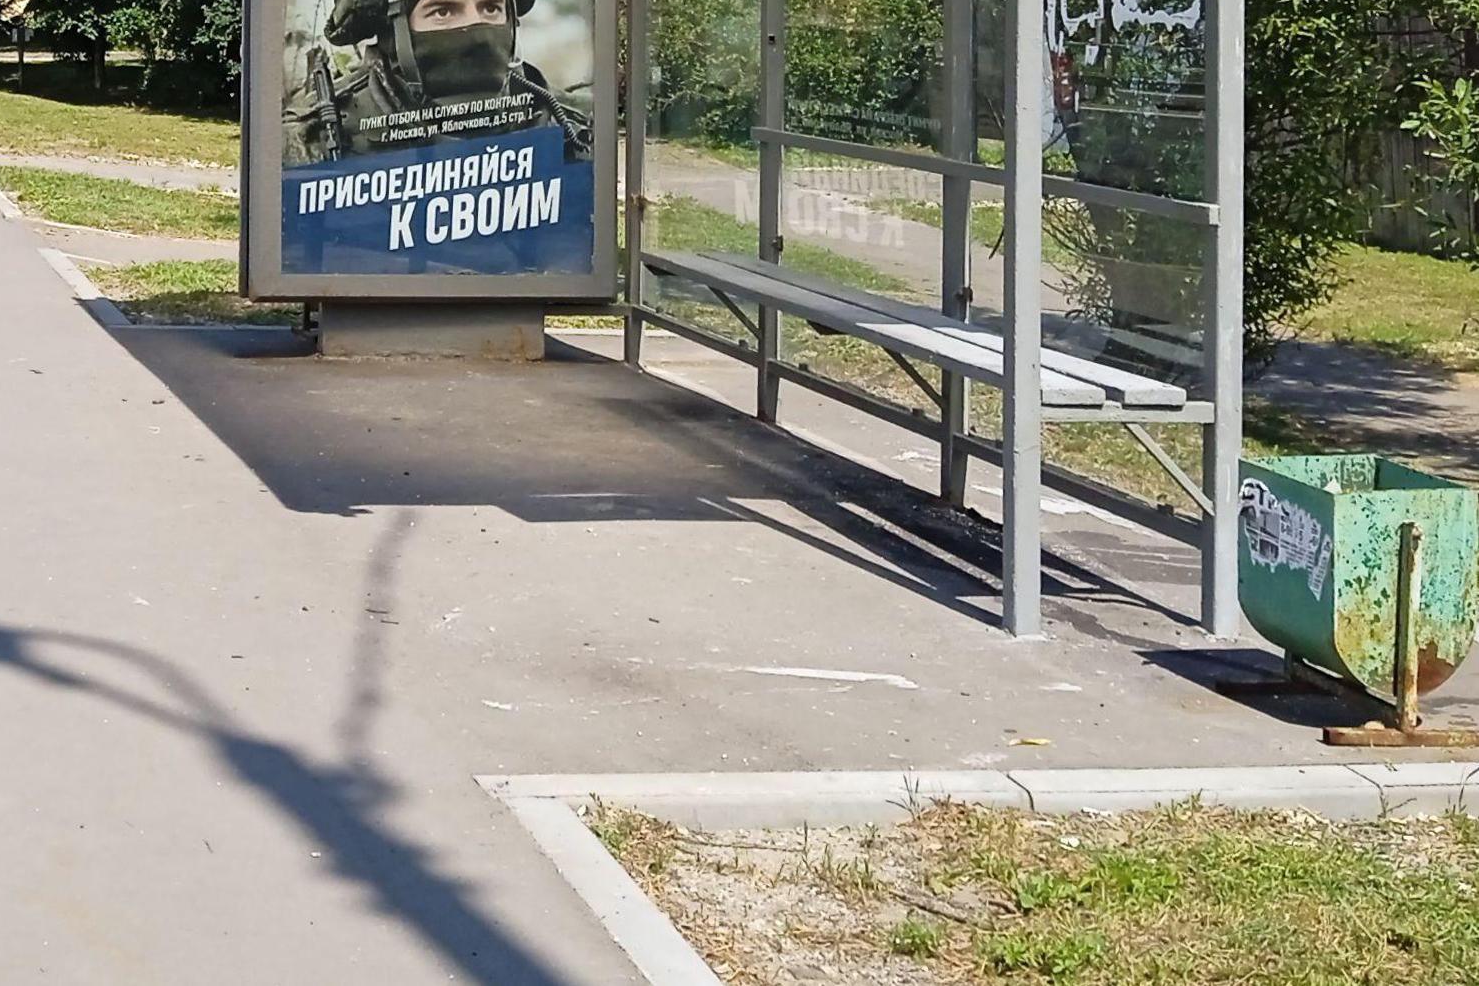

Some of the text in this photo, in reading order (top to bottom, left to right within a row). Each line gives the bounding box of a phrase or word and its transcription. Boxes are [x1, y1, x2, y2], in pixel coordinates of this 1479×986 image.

[359, 92, 535, 131] ПУНКТ ОТБОРА НА СЛУЖБУ ПО КОНТРАКТУ:
[381, 132, 388, 143] г.
[389, 128, 427, 142] Москва,
[427, 124, 440, 139] ул.
[441, 116, 492, 134] Яблочкова,
[508, 110, 526, 124] стр.
[298, 145, 535, 215] ПРИСОЕДИНЯЙСЯ
[388, 178, 562, 251] К СВОИМ
